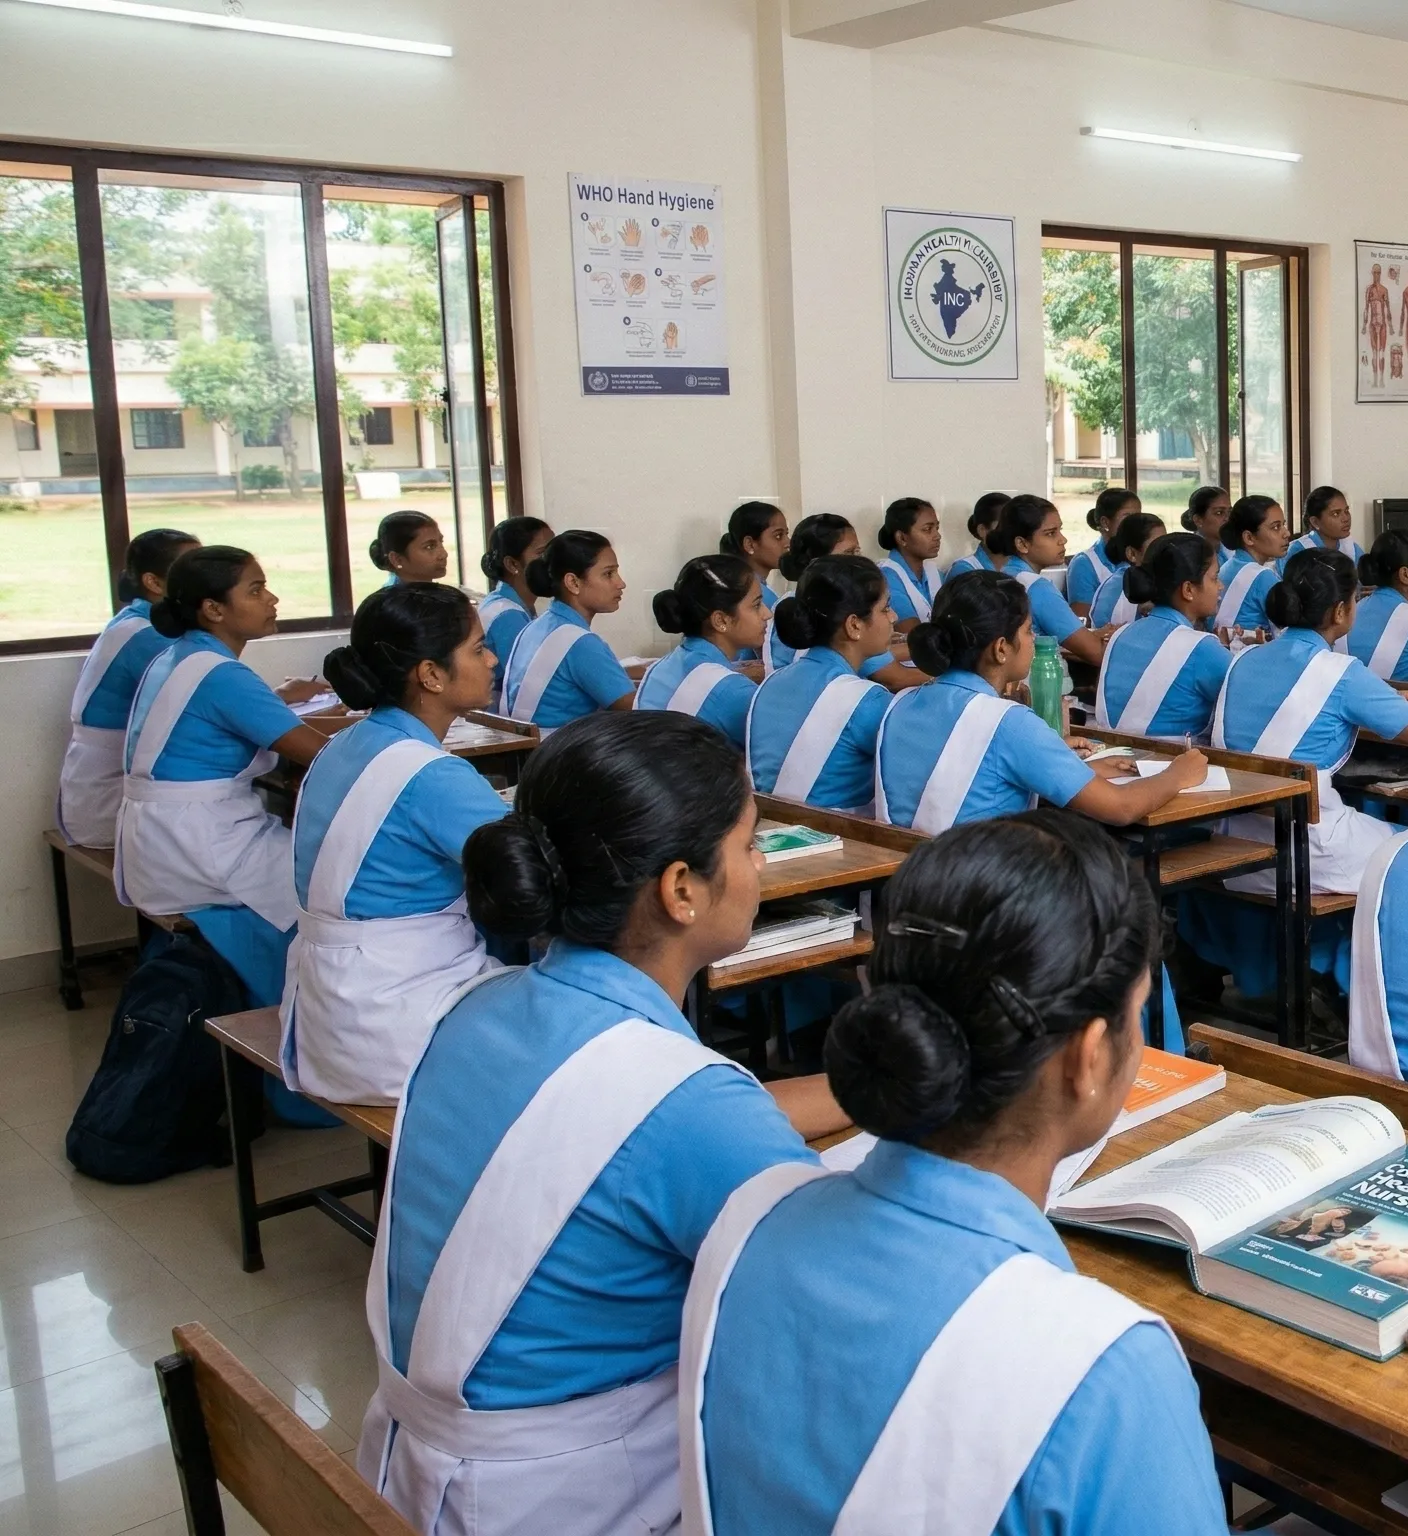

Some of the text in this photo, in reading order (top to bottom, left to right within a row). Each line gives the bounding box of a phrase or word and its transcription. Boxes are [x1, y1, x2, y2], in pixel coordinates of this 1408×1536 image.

[576, 184, 714, 212] WHO Hand Hygiene
[943, 291, 965, 307] INC
